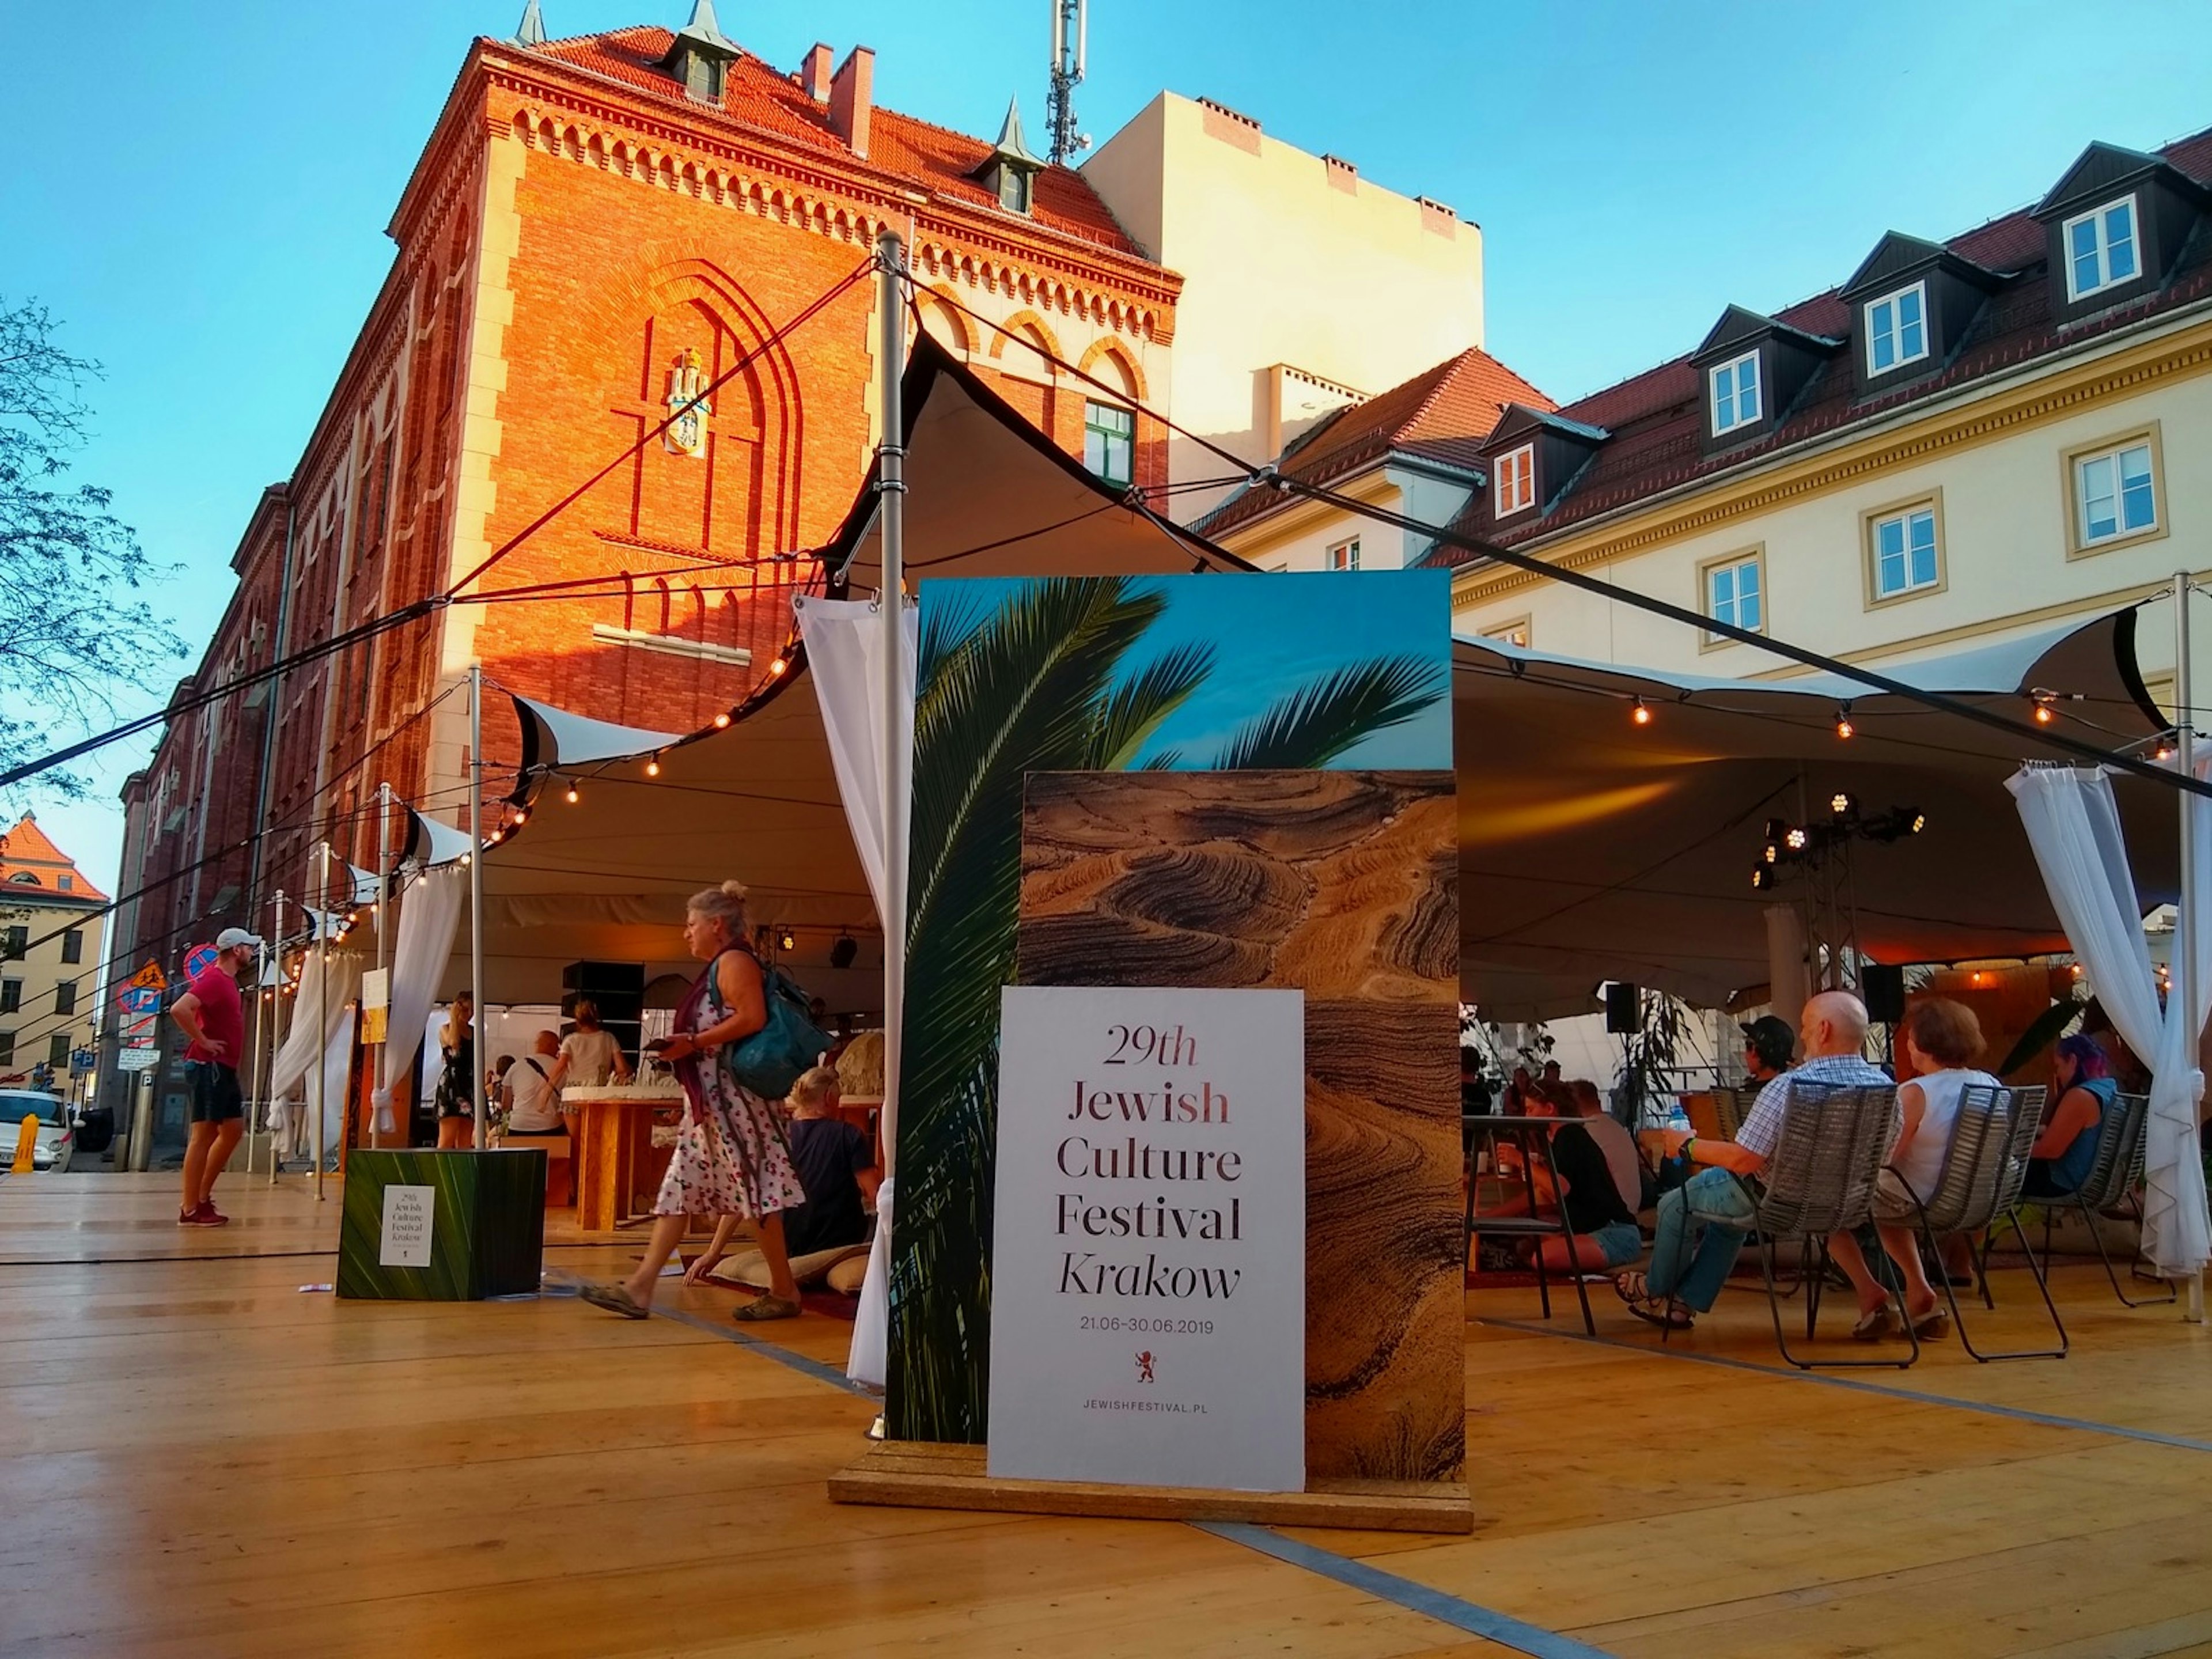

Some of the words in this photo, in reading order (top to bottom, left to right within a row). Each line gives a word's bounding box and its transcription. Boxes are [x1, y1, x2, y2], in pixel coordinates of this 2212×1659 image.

[137, 990, 155, 1009] P
[1103, 1024, 1198, 1066] 29th
[82, 1054, 93, 1065] P
[143, 1075, 152, 1086] P
[1067, 1081, 1231, 1123] Jewish
[1056, 1137, 1242, 1182] Culture
[1055, 1194, 1243, 1240] Festival
[392, 1222, 423, 1232] Festival
[1056, 1252, 1241, 1300] Krakow
[1080, 1316, 1214, 1335] 21.06-30.06.2019
[1084, 1399, 1209, 1414] JEWISHFESTIVAL.PL
